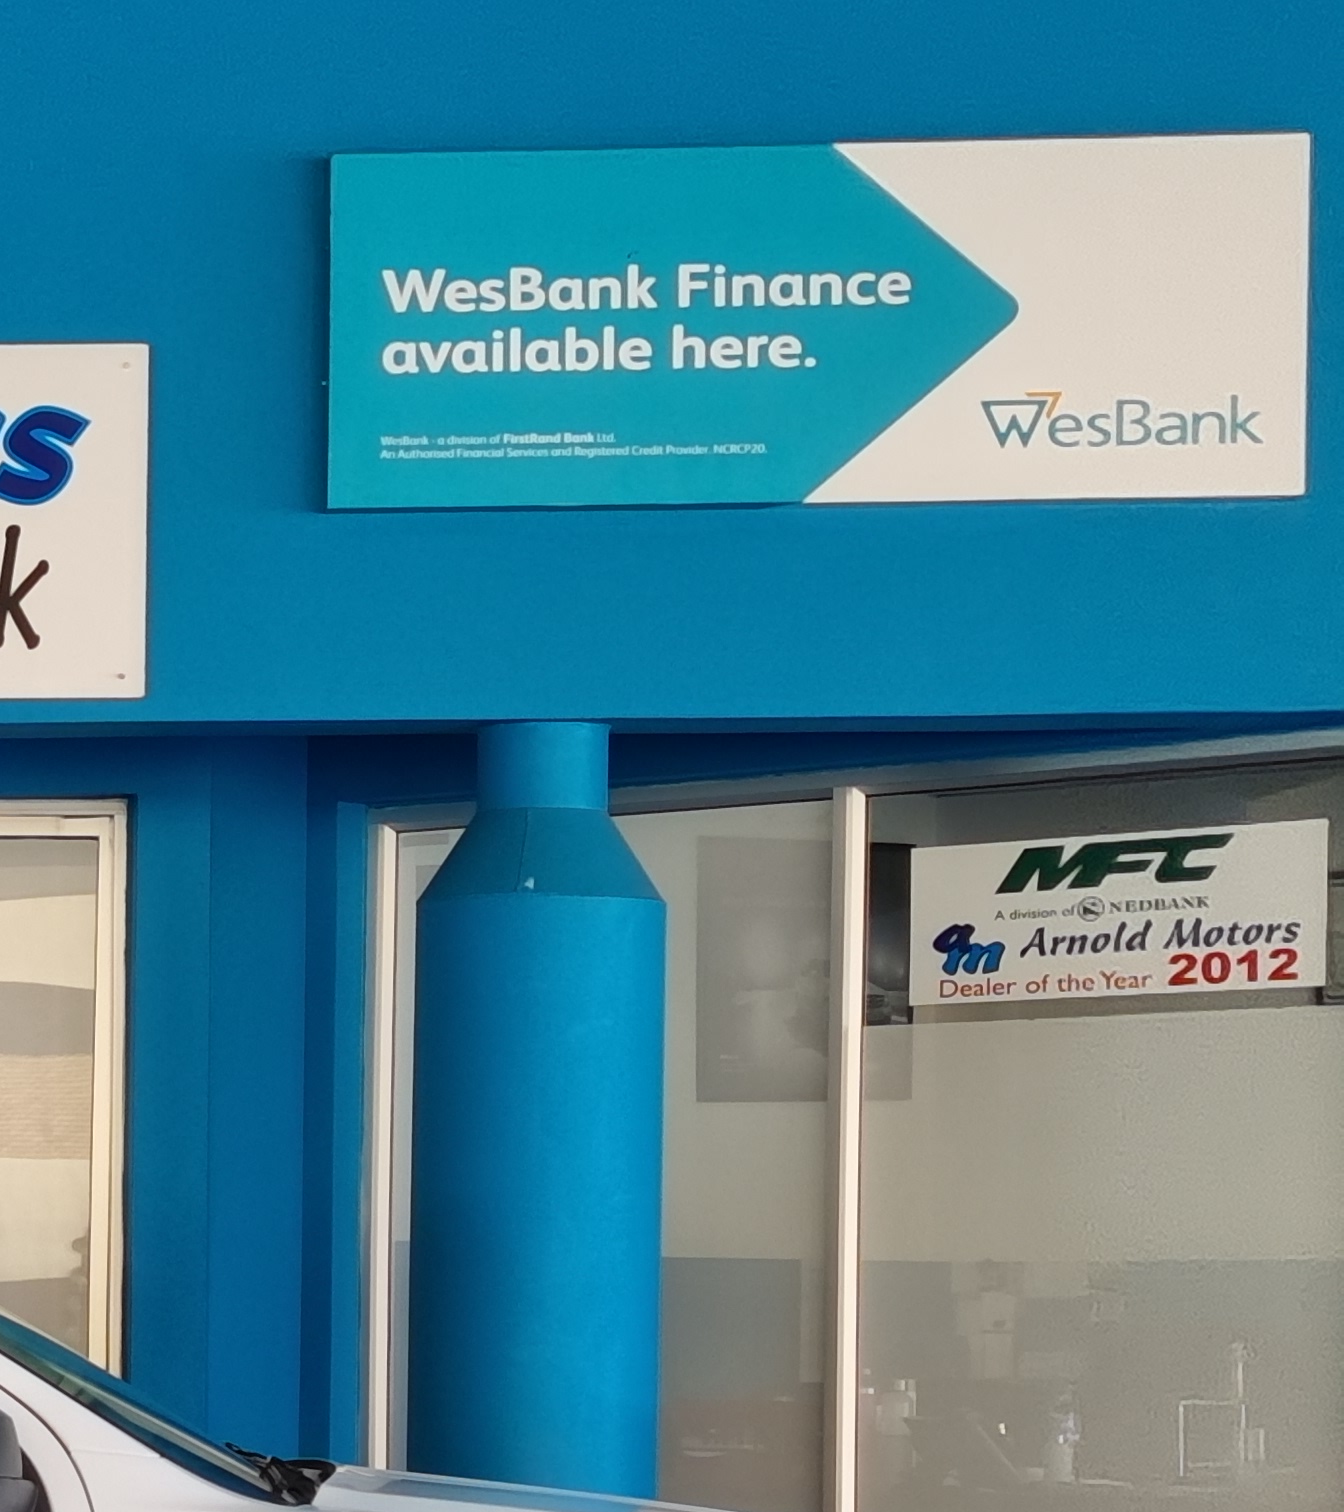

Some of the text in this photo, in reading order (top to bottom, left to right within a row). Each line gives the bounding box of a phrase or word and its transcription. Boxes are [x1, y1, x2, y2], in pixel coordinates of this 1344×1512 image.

[382, 263, 912, 313] WesBank Finance
[382, 326, 816, 375] available here.
[380, 435, 429, 446] WesBank
[437, 437, 445, 445] a
[447, 434, 487, 445] division
[489, 434, 501, 444] of
[503, 433, 561, 444] FirstRand
[564, 432, 594, 443] Bank
[597, 432, 616, 443] Ltd.
[981, 392, 1263, 448] WesBank
[380, 449, 395, 459] An
[398, 449, 455, 459] Authorised
[456, 447, 504, 458] Financial
[507, 447, 549, 458] Services
[551, 447, 572, 457] and
[574, 446, 629, 459] Registered
[632, 445, 663, 456] Credit
[995, 833, 1235, 894] MFC
[994, 896, 1210, 921] A division of NEDBANK
[1020, 917, 1301, 958] Arnold Motors
[939, 948, 1299, 998] Dealer of the Year 2012
